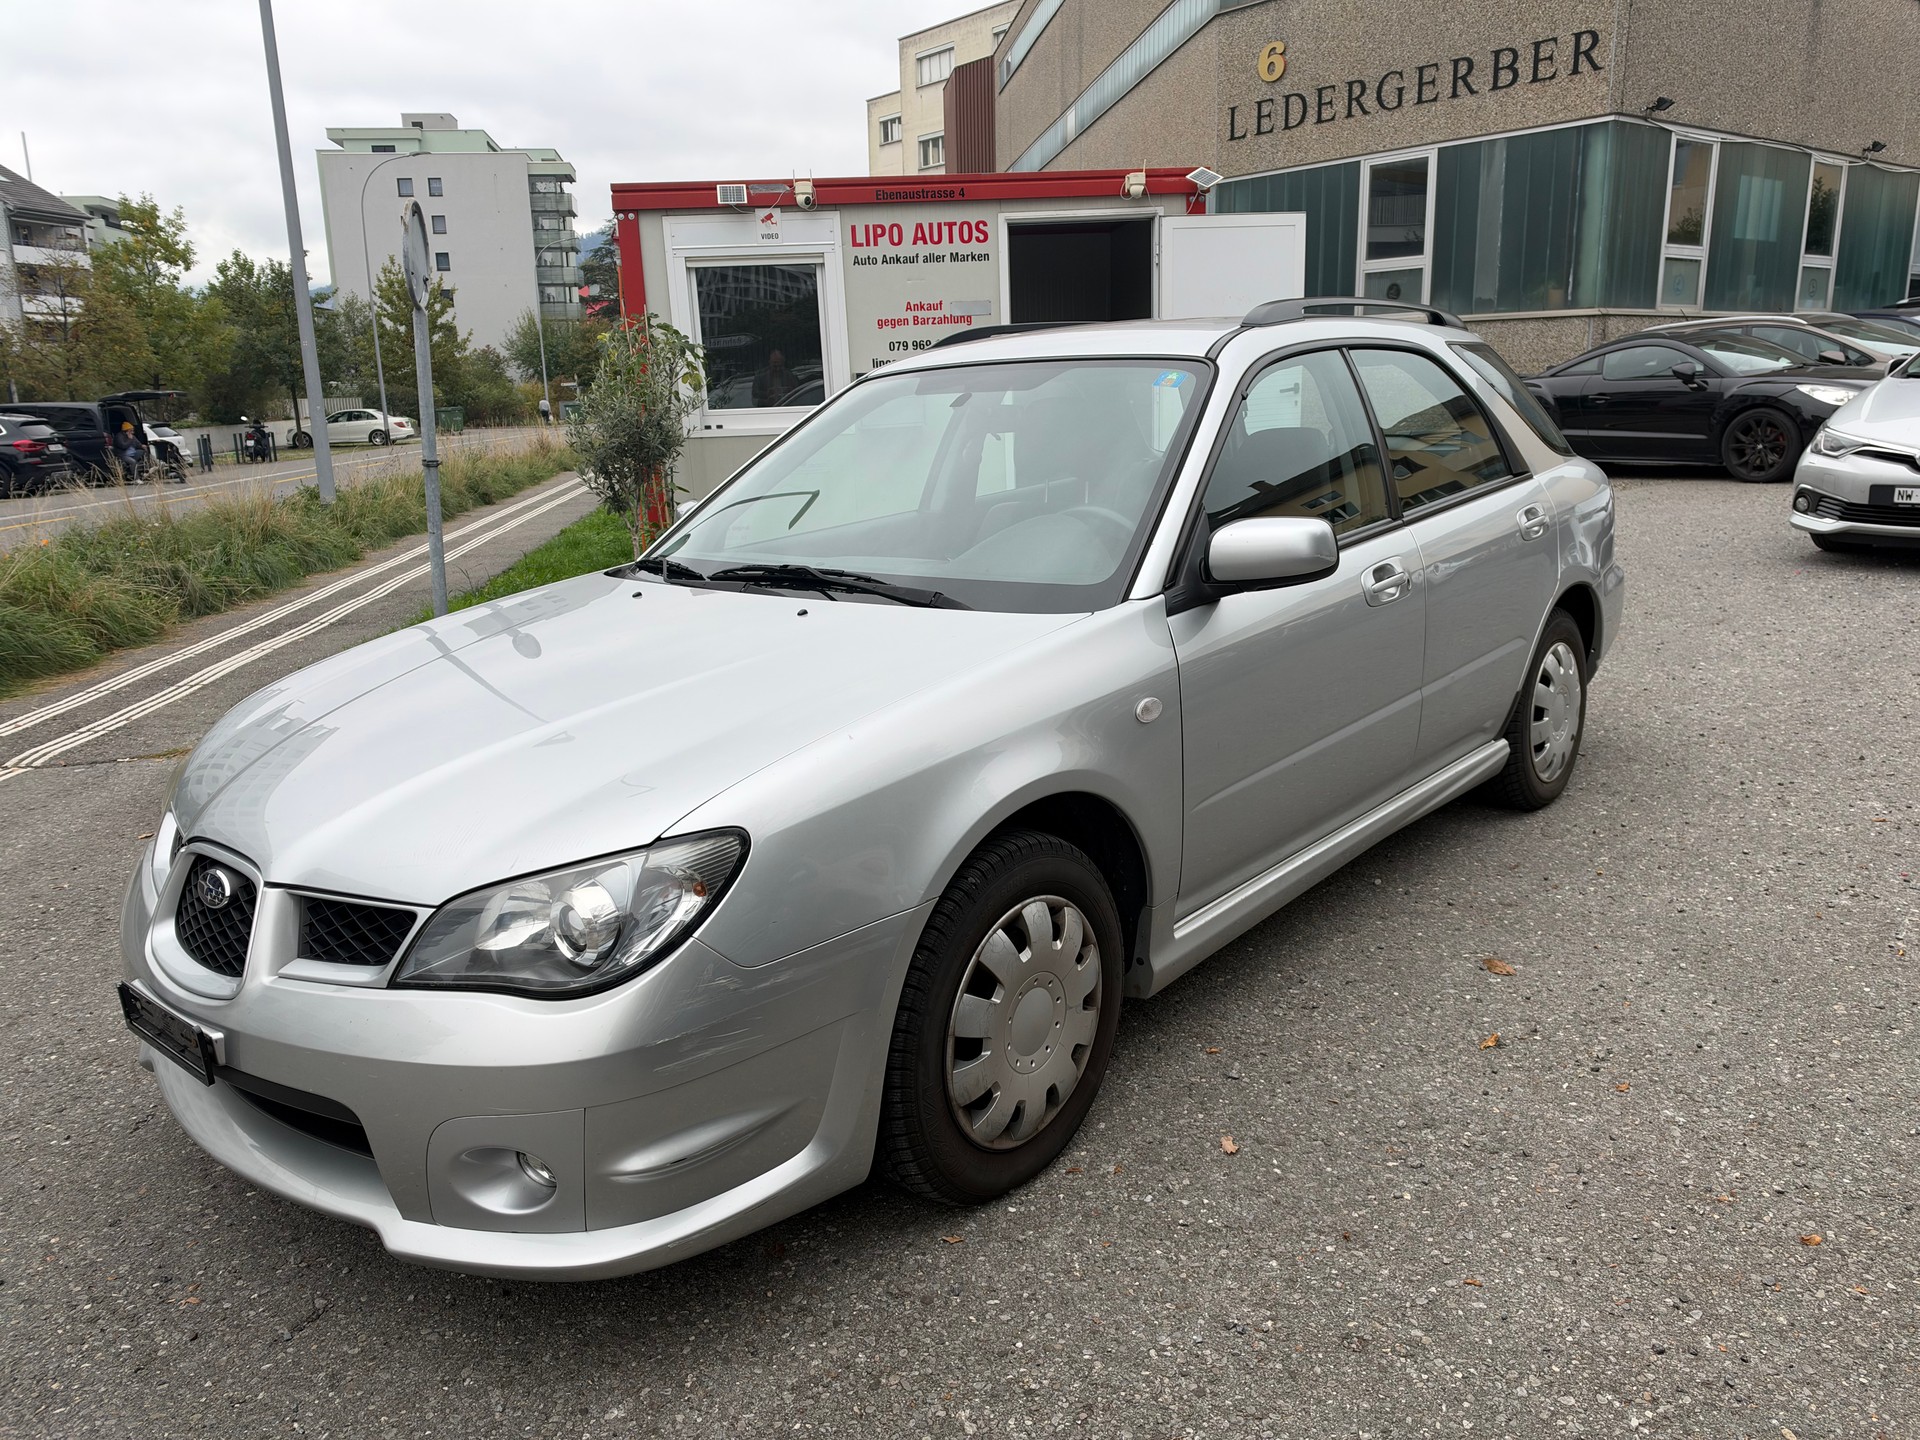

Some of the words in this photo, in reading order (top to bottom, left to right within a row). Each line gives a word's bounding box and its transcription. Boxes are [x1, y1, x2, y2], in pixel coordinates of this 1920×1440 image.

[1257, 40, 1287, 83] 6
[1226, 28, 1604, 142] LEDERGERBER
[875, 188, 955, 201] Ebenaustrasse
[958, 187, 966, 198] 4
[760, 232, 779, 241] VIDEO
[850, 222, 904, 248] LIPO
[911, 219, 989, 246] AUTOS
[852, 254, 878, 267] Auto
[881, 252, 919, 266] Ankauf
[922, 252, 947, 264] aller
[949, 251, 990, 263] Marken
[905, 300, 943, 312] Ankauf
[877, 317, 909, 330] gegen
[912, 313, 973, 327] Barzahlung
[888, 340, 909, 352] 079
[1897, 489, 1914, 502] NW
